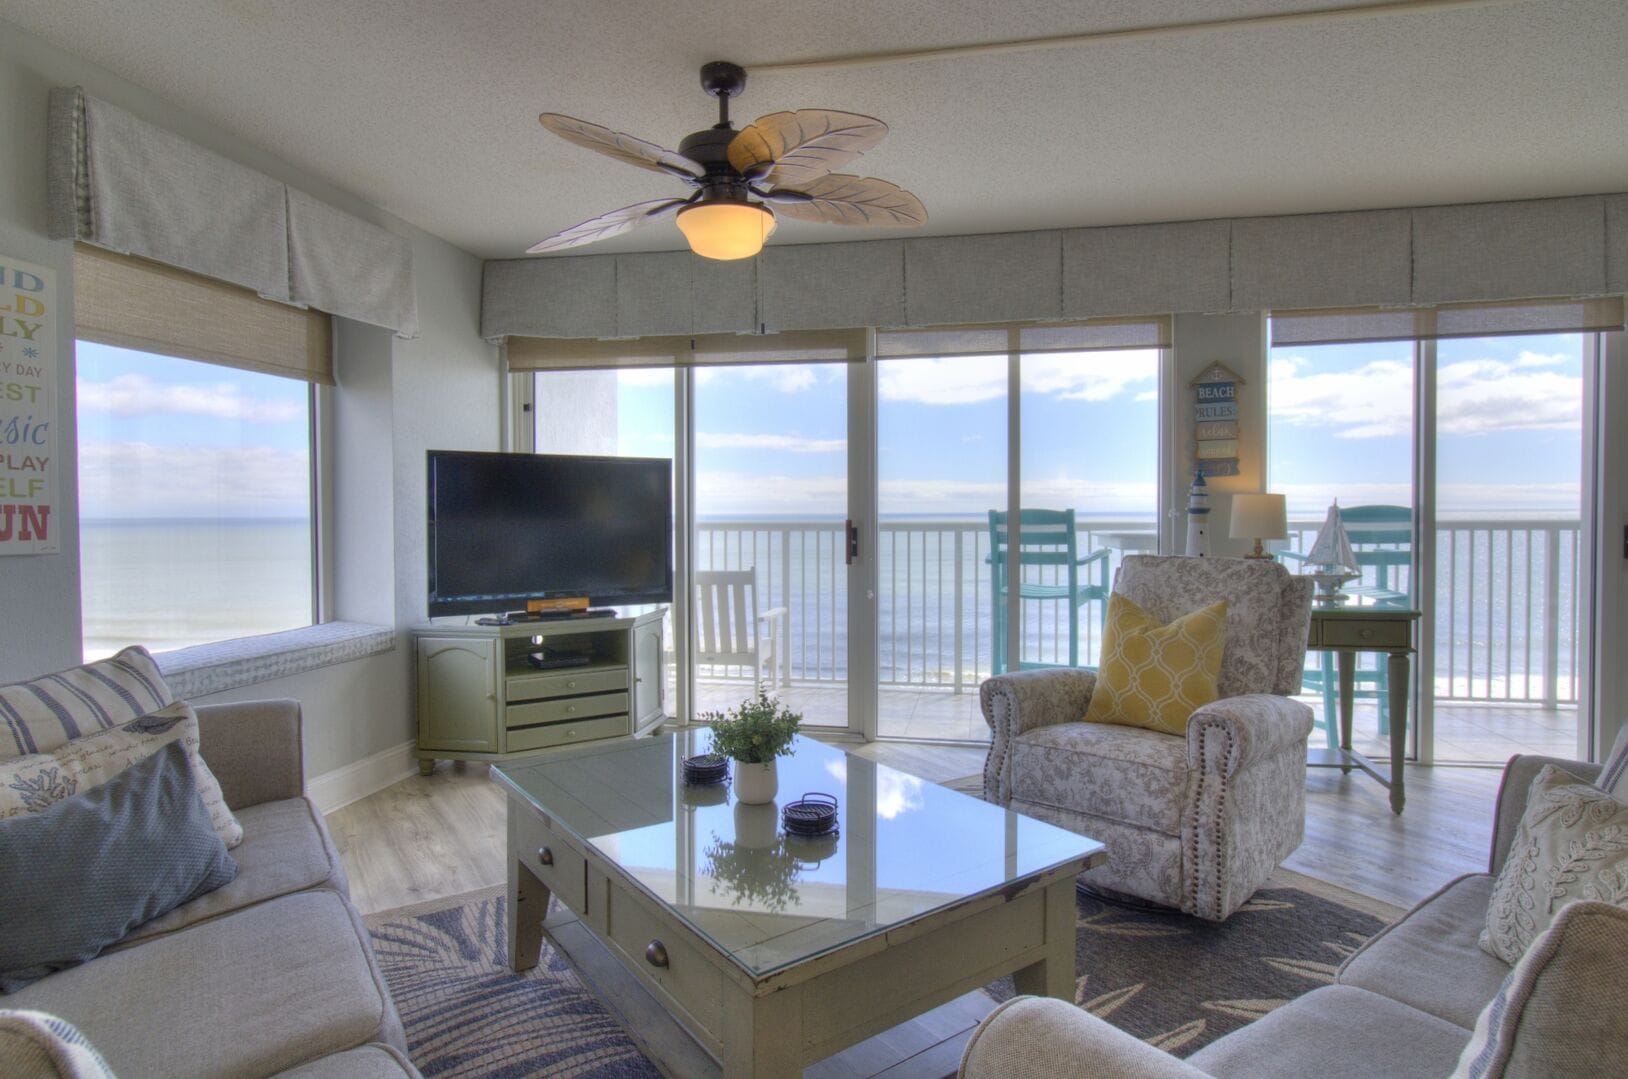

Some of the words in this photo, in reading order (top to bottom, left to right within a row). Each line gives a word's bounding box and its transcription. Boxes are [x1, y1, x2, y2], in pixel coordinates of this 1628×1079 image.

[16, 364, 42, 378] DAY
[0, 381, 42, 403] ST
[1198, 386, 1234, 399] BEACH
[0, 415, 49, 445] sic
